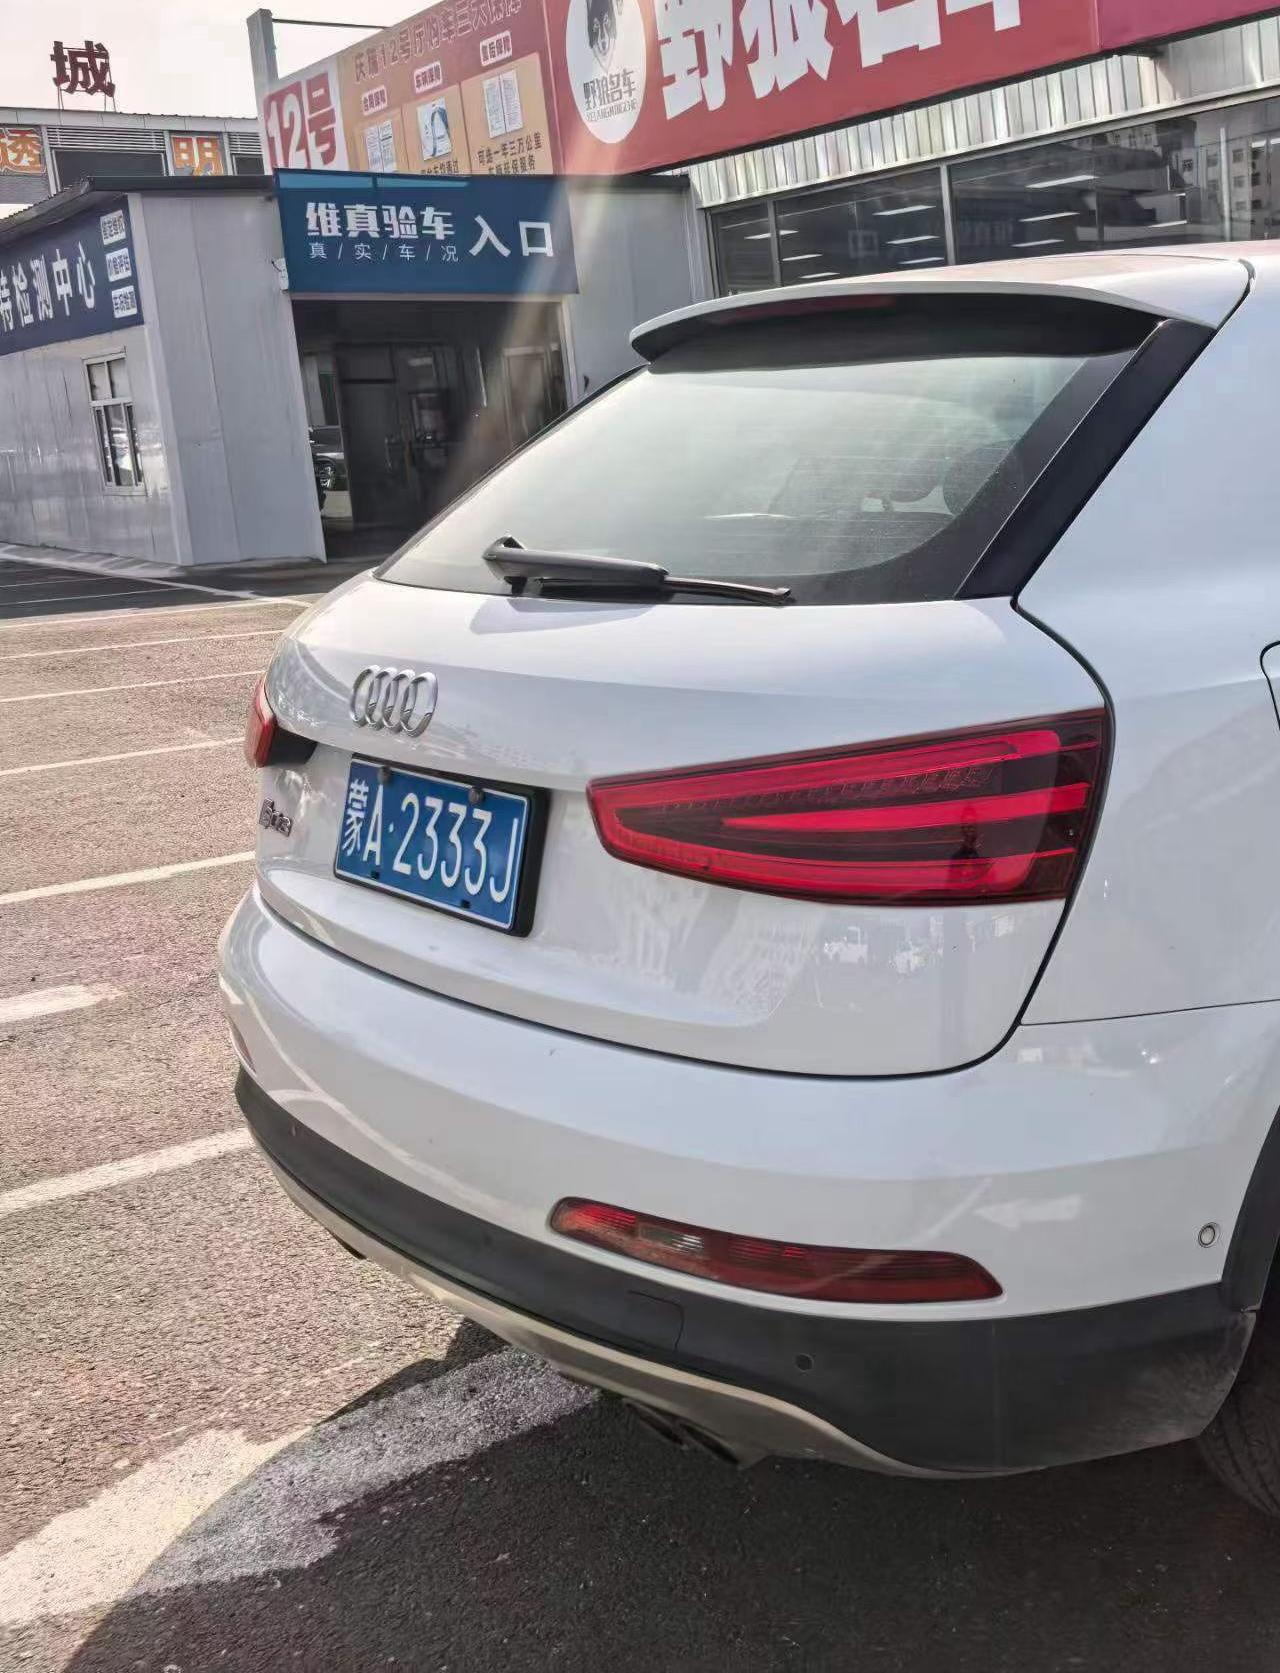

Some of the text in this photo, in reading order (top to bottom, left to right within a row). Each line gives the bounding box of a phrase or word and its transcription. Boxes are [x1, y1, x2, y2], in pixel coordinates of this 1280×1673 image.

[50, 41, 116, 97] 城
[583, 69, 637, 111] 野狼名车
[305, 202, 554, 257] 维真验车 入口
